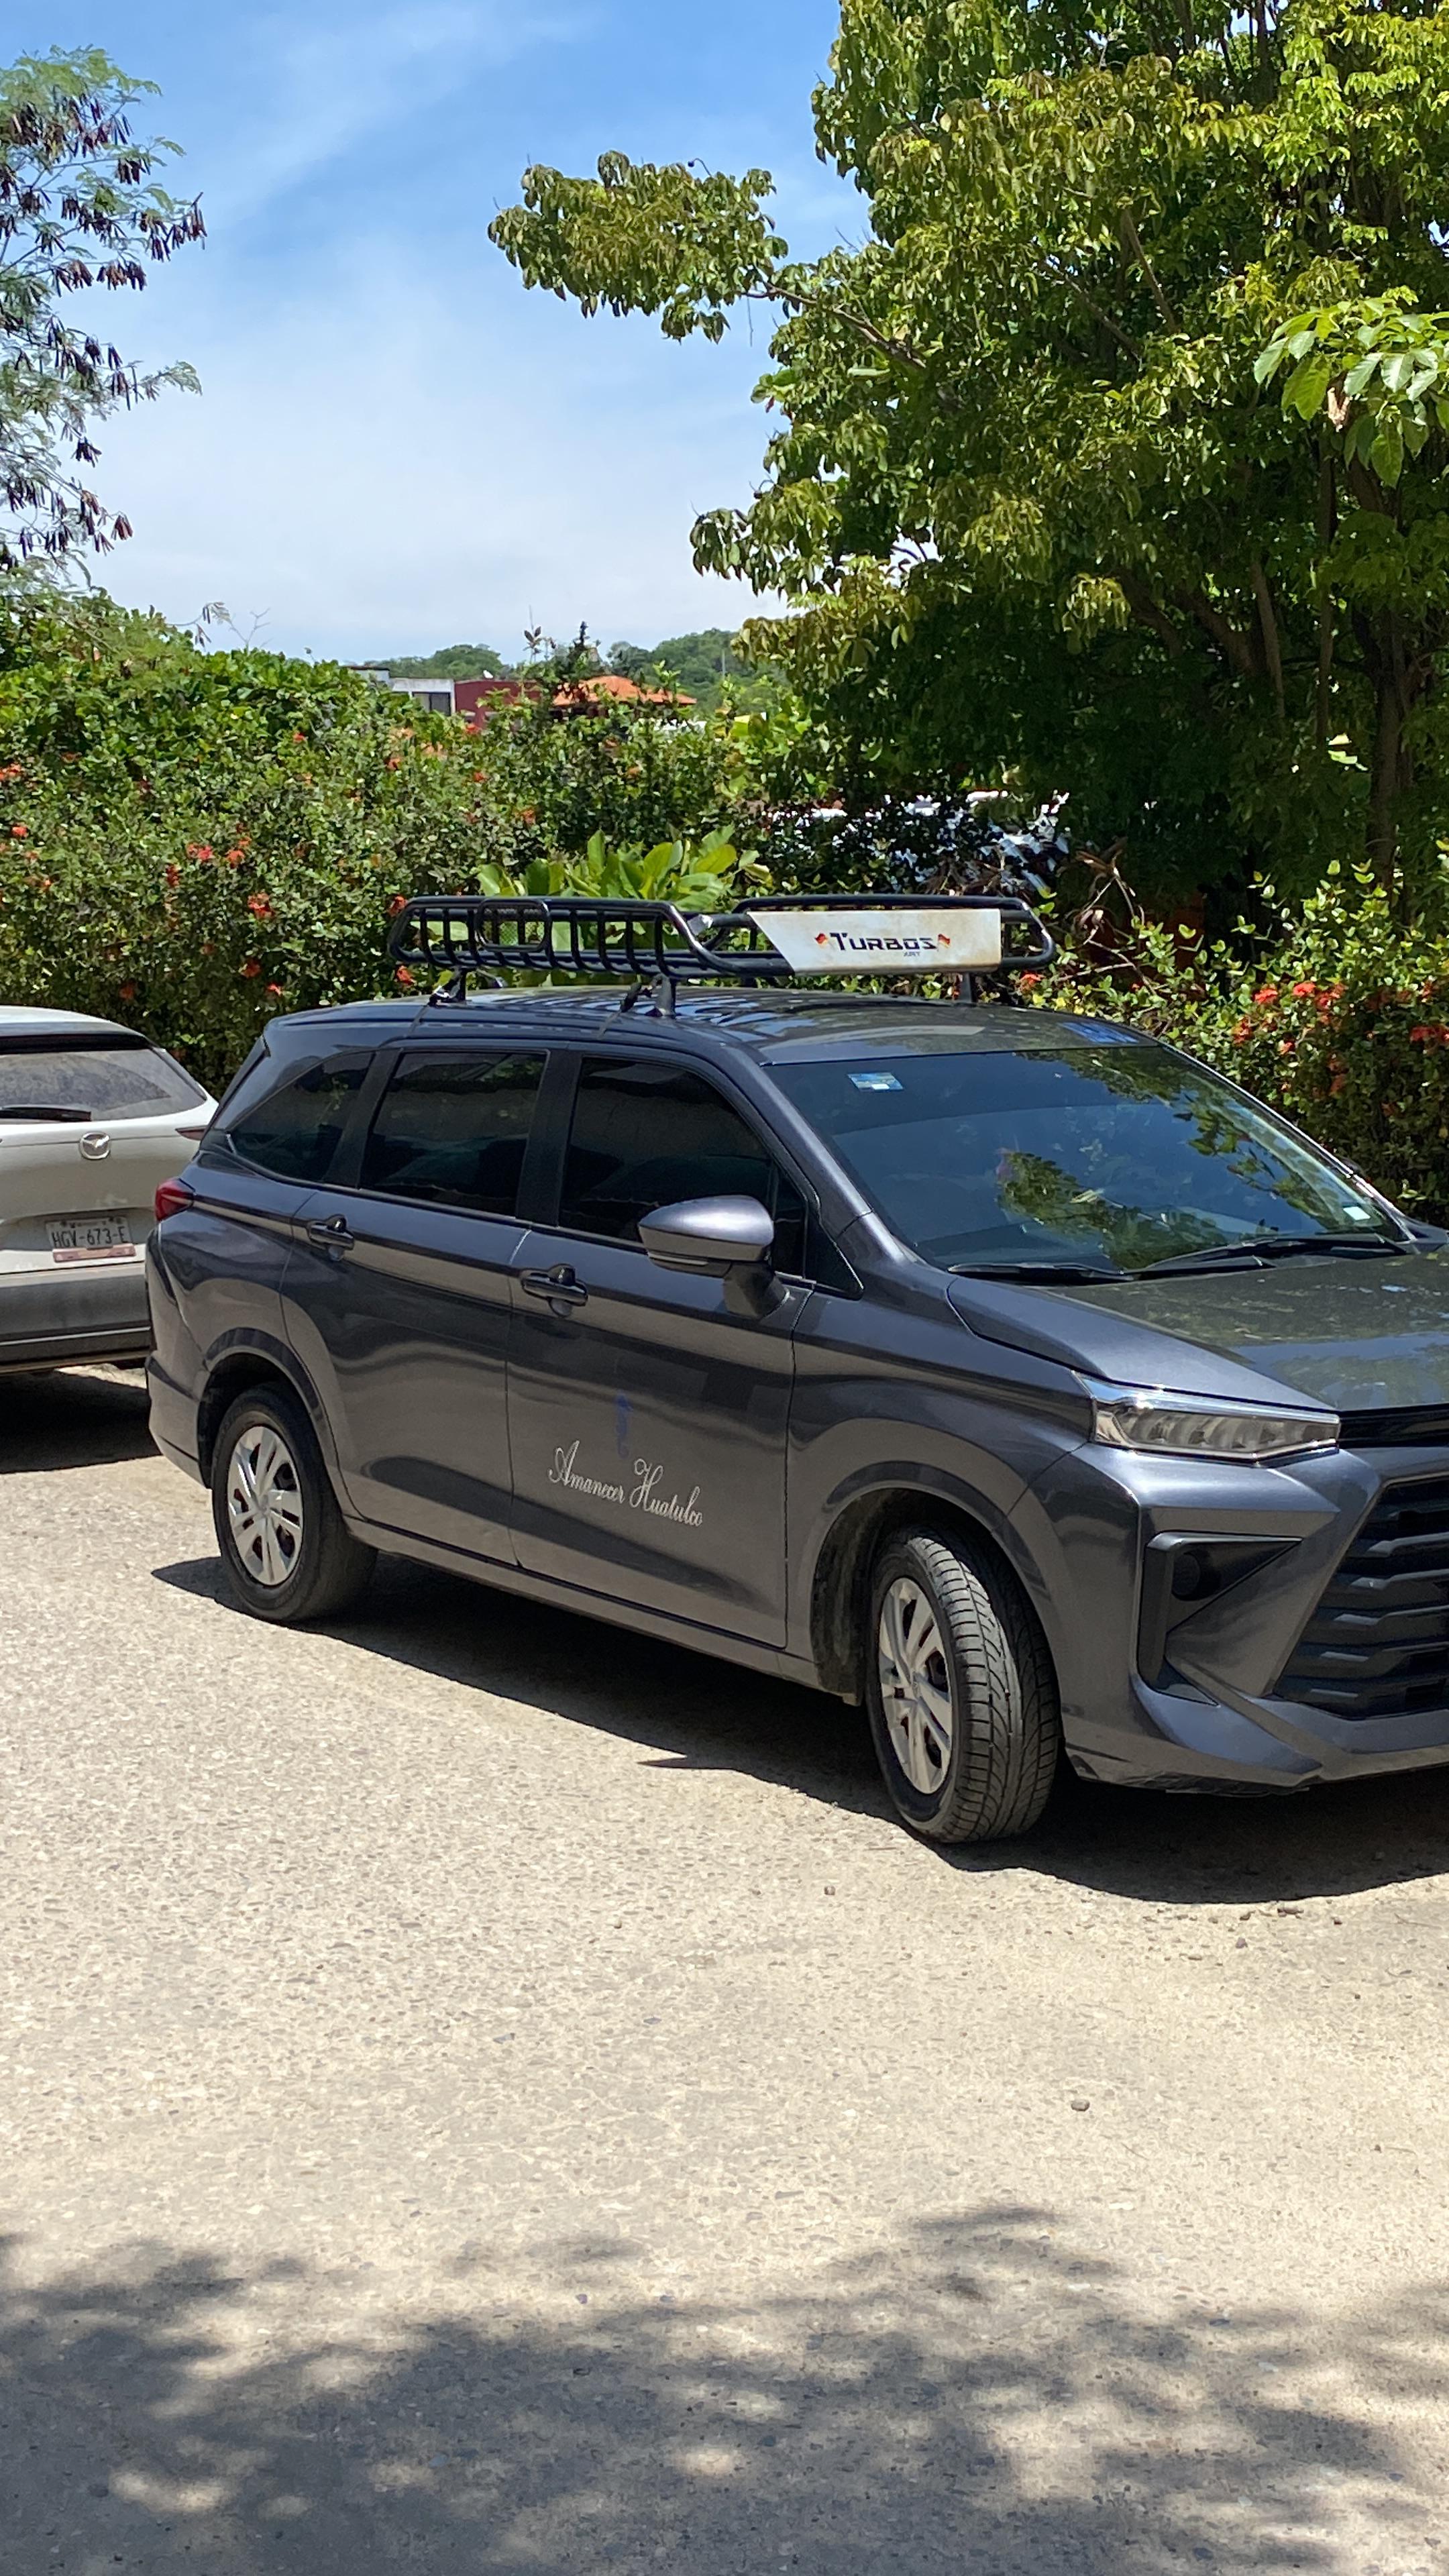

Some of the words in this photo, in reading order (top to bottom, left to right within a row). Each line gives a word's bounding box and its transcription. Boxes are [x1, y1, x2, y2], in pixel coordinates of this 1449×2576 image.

[51, 1226, 129, 1249] HGV-673-E
[547, 1440, 625, 1504] Amanecer
[629, 1458, 703, 1527] Huatulco
